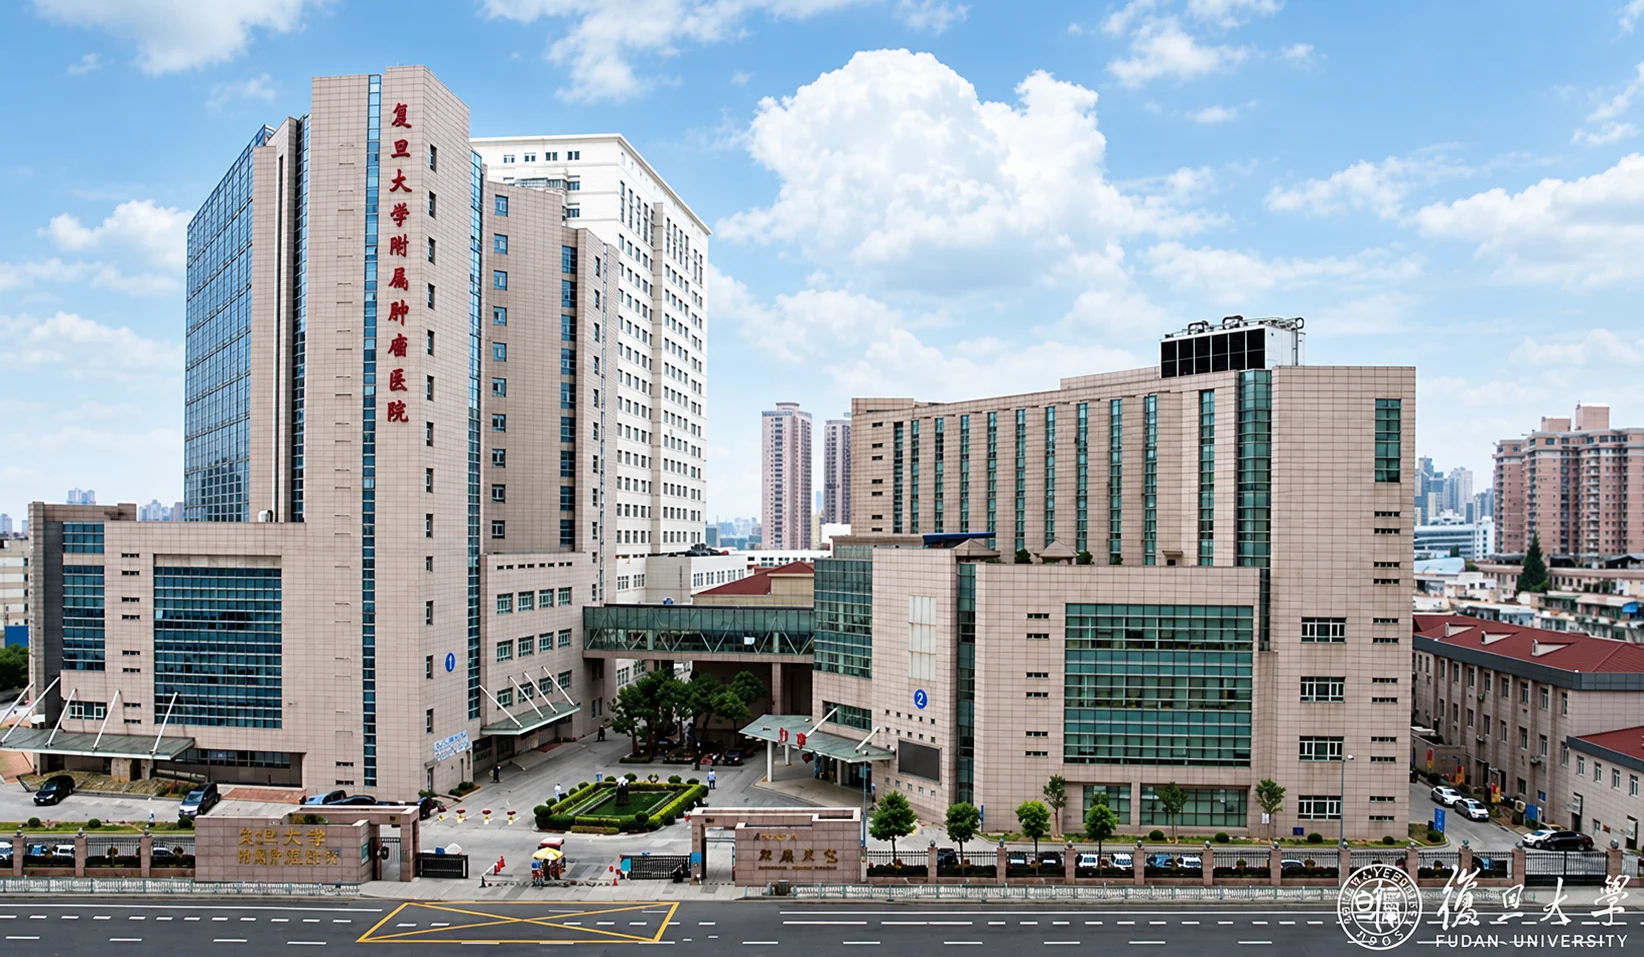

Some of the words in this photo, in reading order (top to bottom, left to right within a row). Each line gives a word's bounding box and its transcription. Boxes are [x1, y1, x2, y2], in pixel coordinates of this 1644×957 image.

[387, 102, 412, 423] 复旦大学附属肿瘤医院
